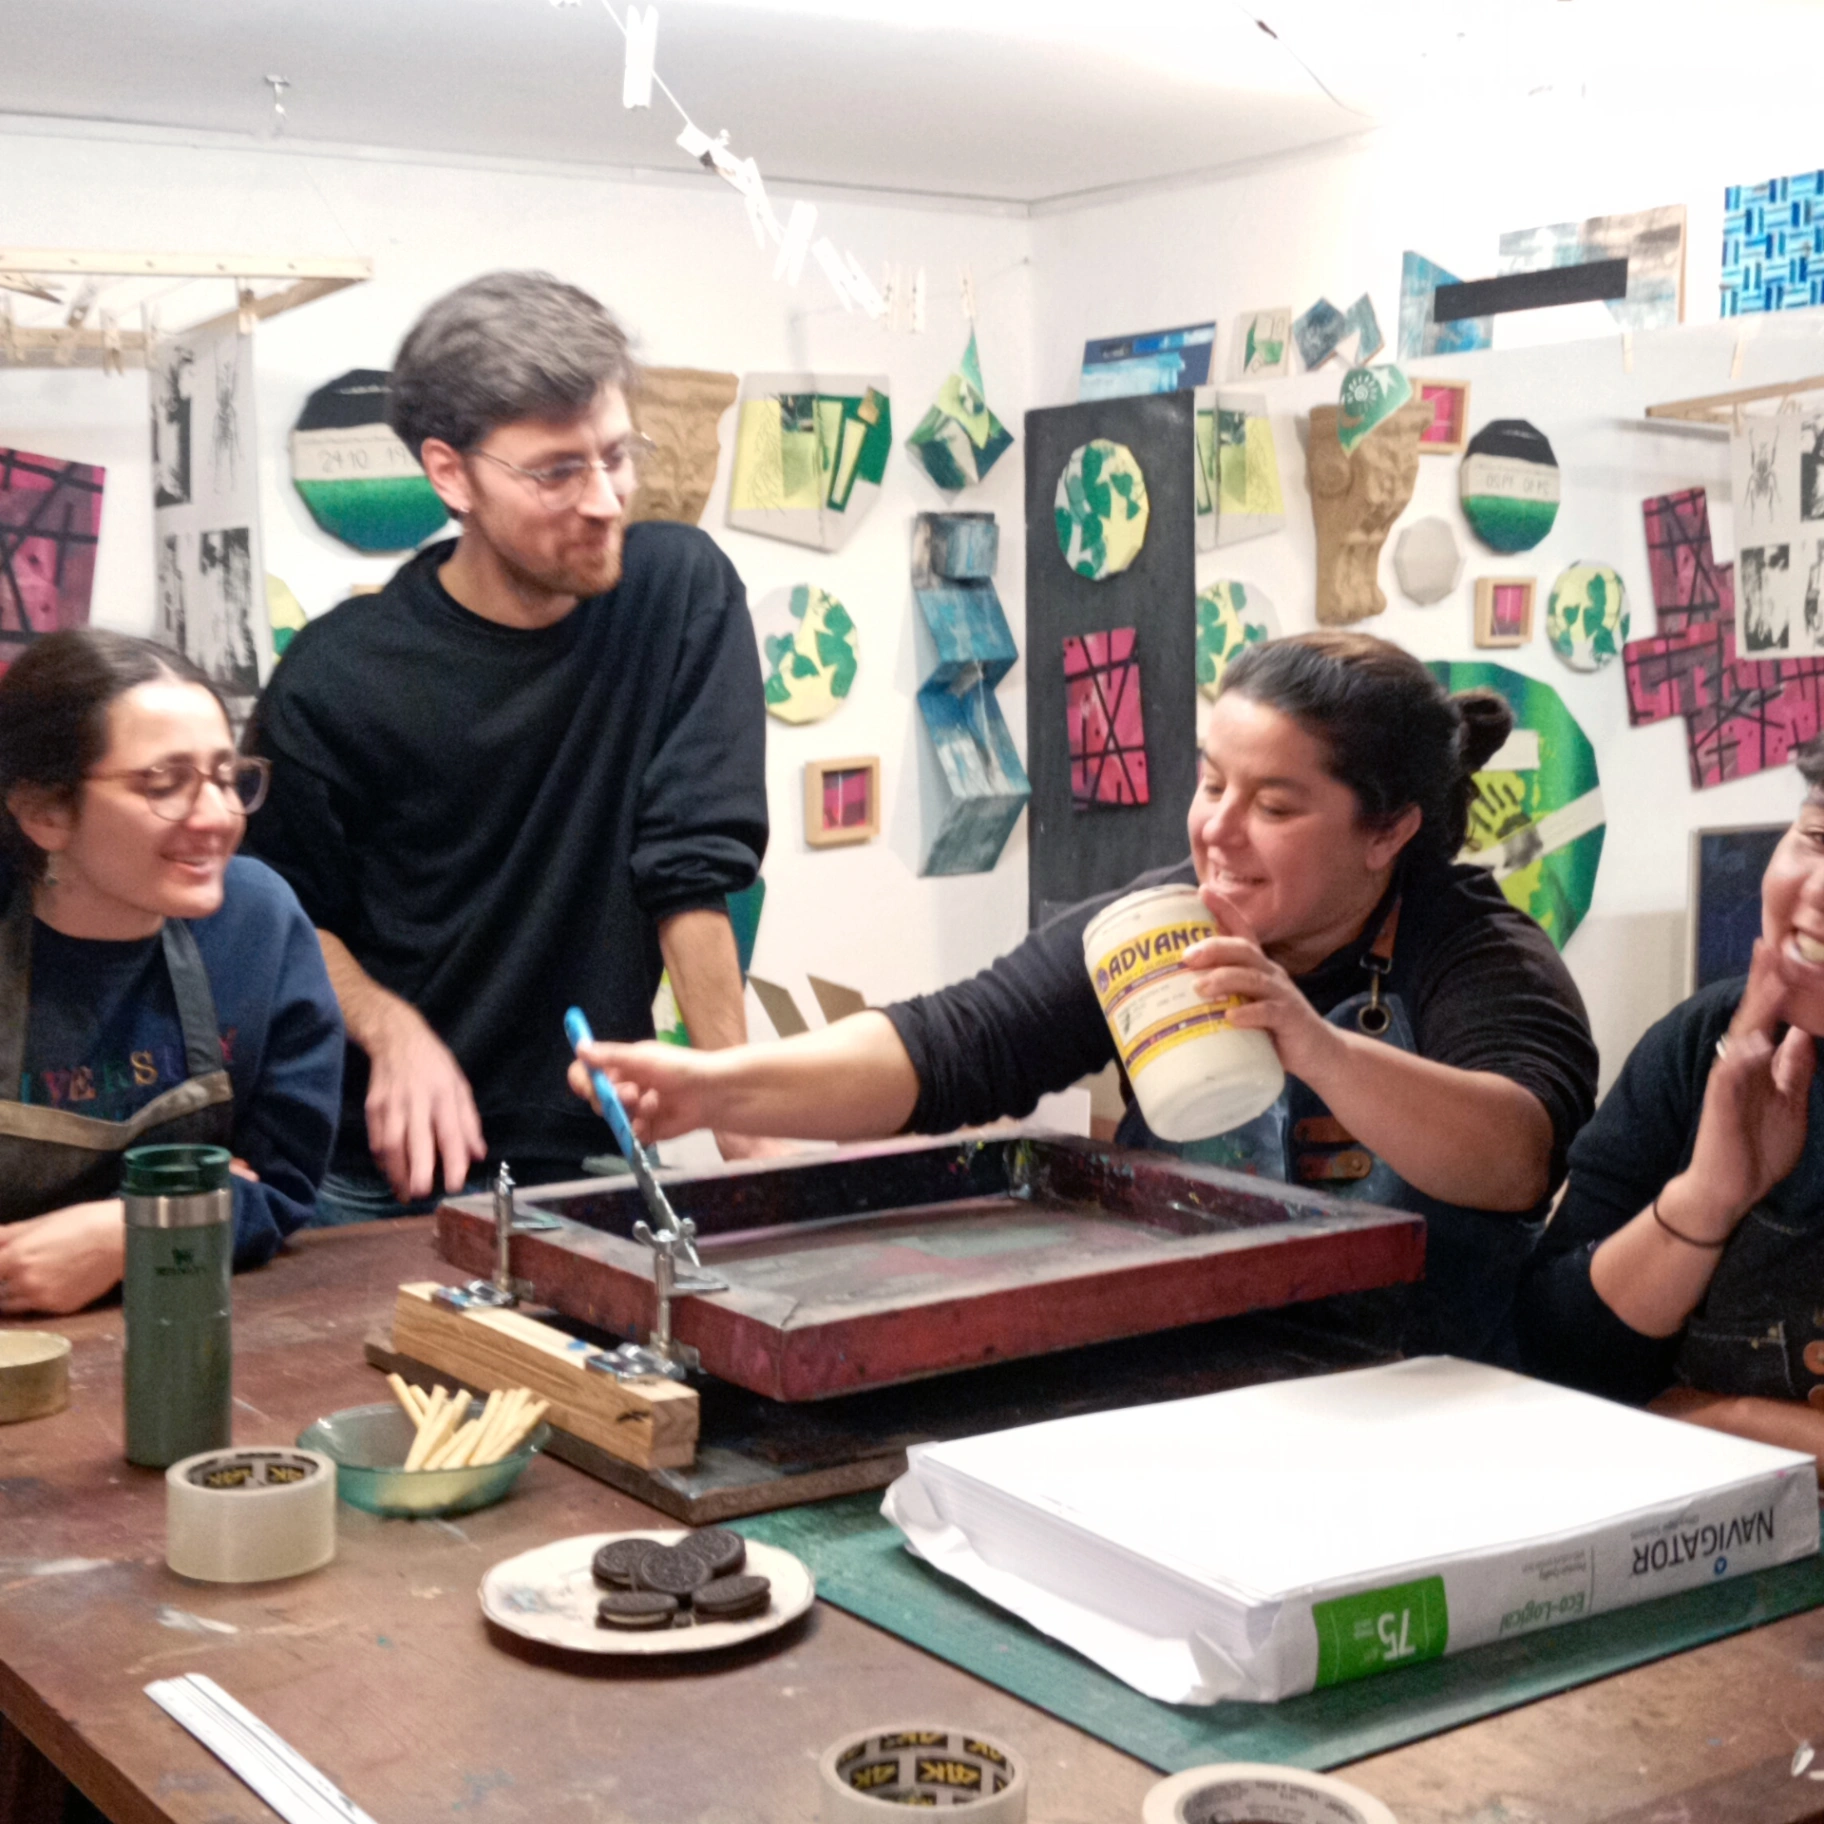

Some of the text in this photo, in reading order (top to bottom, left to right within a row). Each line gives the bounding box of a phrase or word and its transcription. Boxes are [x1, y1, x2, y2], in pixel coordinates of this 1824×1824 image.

[1632, 1506, 1774, 1575] NAVIGATOR
[1377, 1608, 1416, 1661] 75
[1499, 1591, 1585, 1634] Eco-Logical
